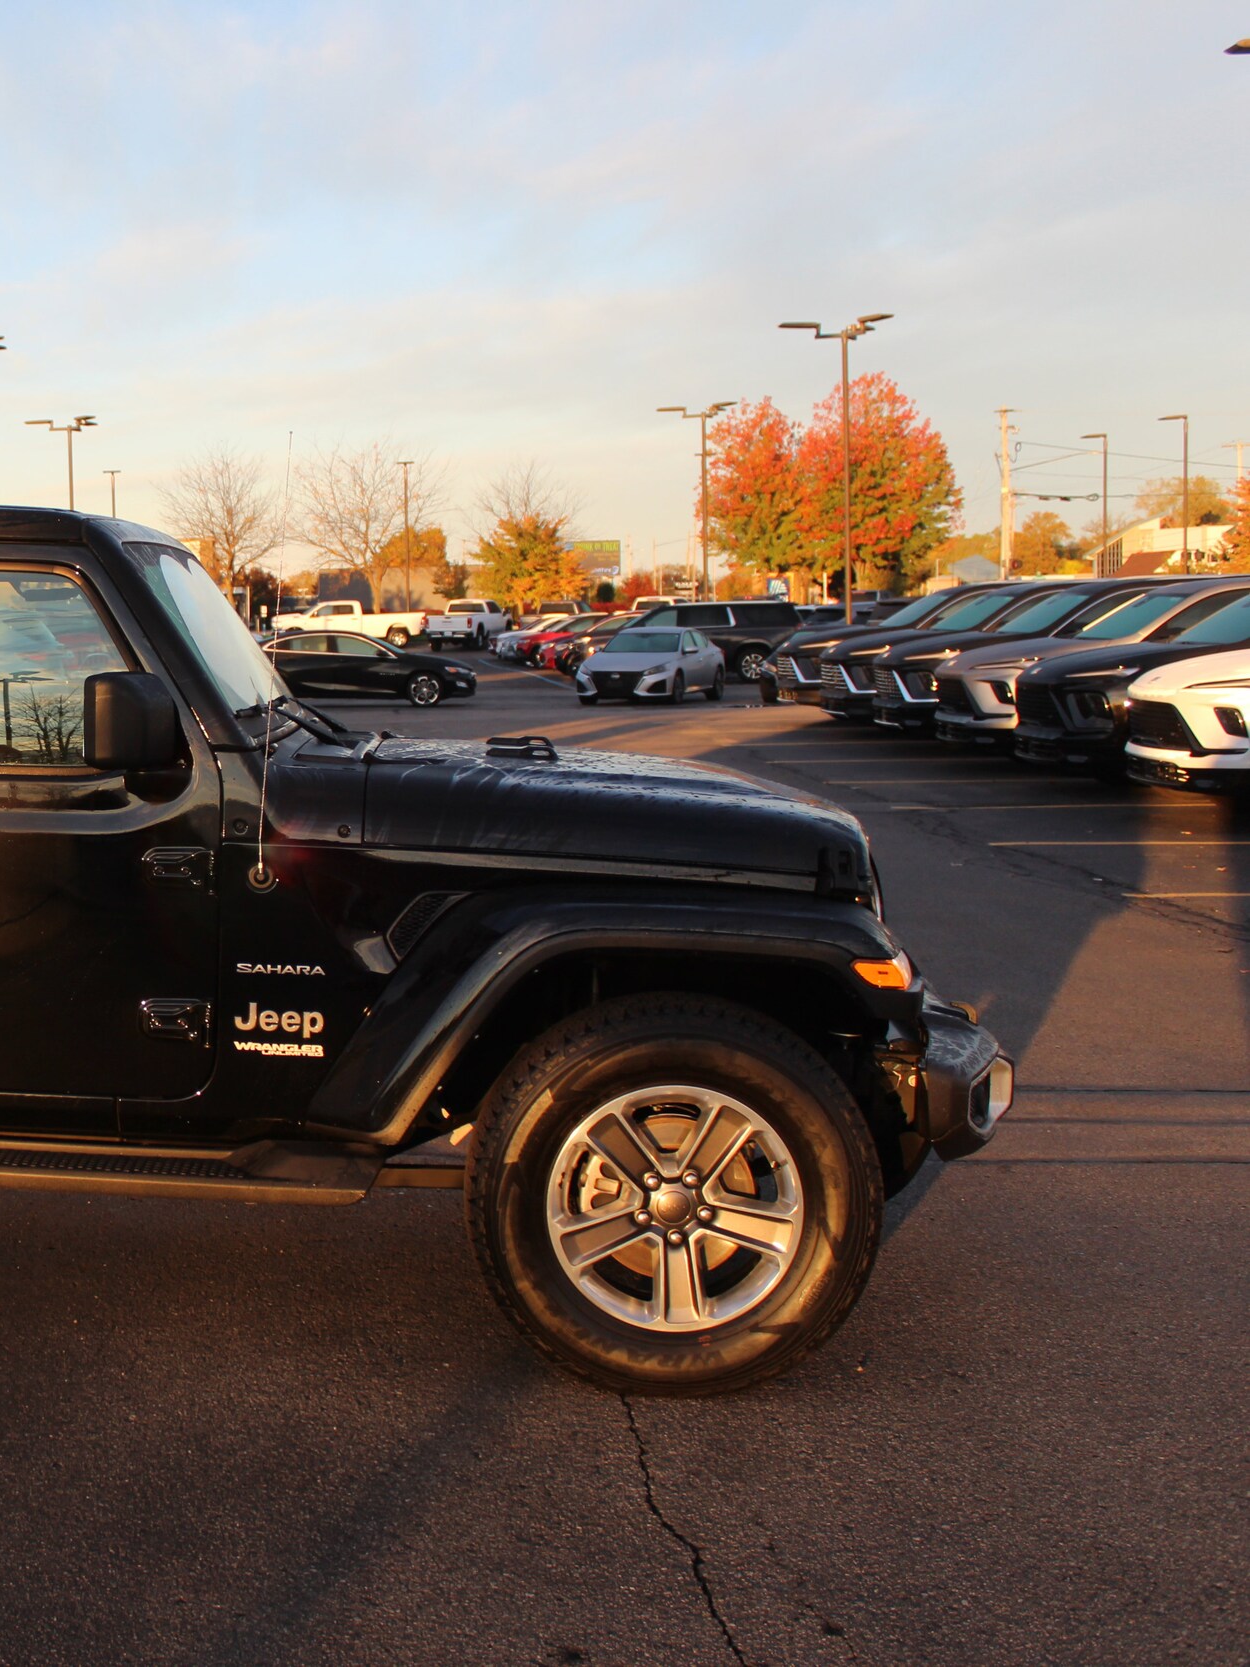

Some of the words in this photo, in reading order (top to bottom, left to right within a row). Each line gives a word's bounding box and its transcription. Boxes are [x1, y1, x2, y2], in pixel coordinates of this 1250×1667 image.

[236, 963, 326, 976] SAHARA
[234, 1002, 324, 1039] Jeep
[233, 1041, 324, 1053] WRANGLER
